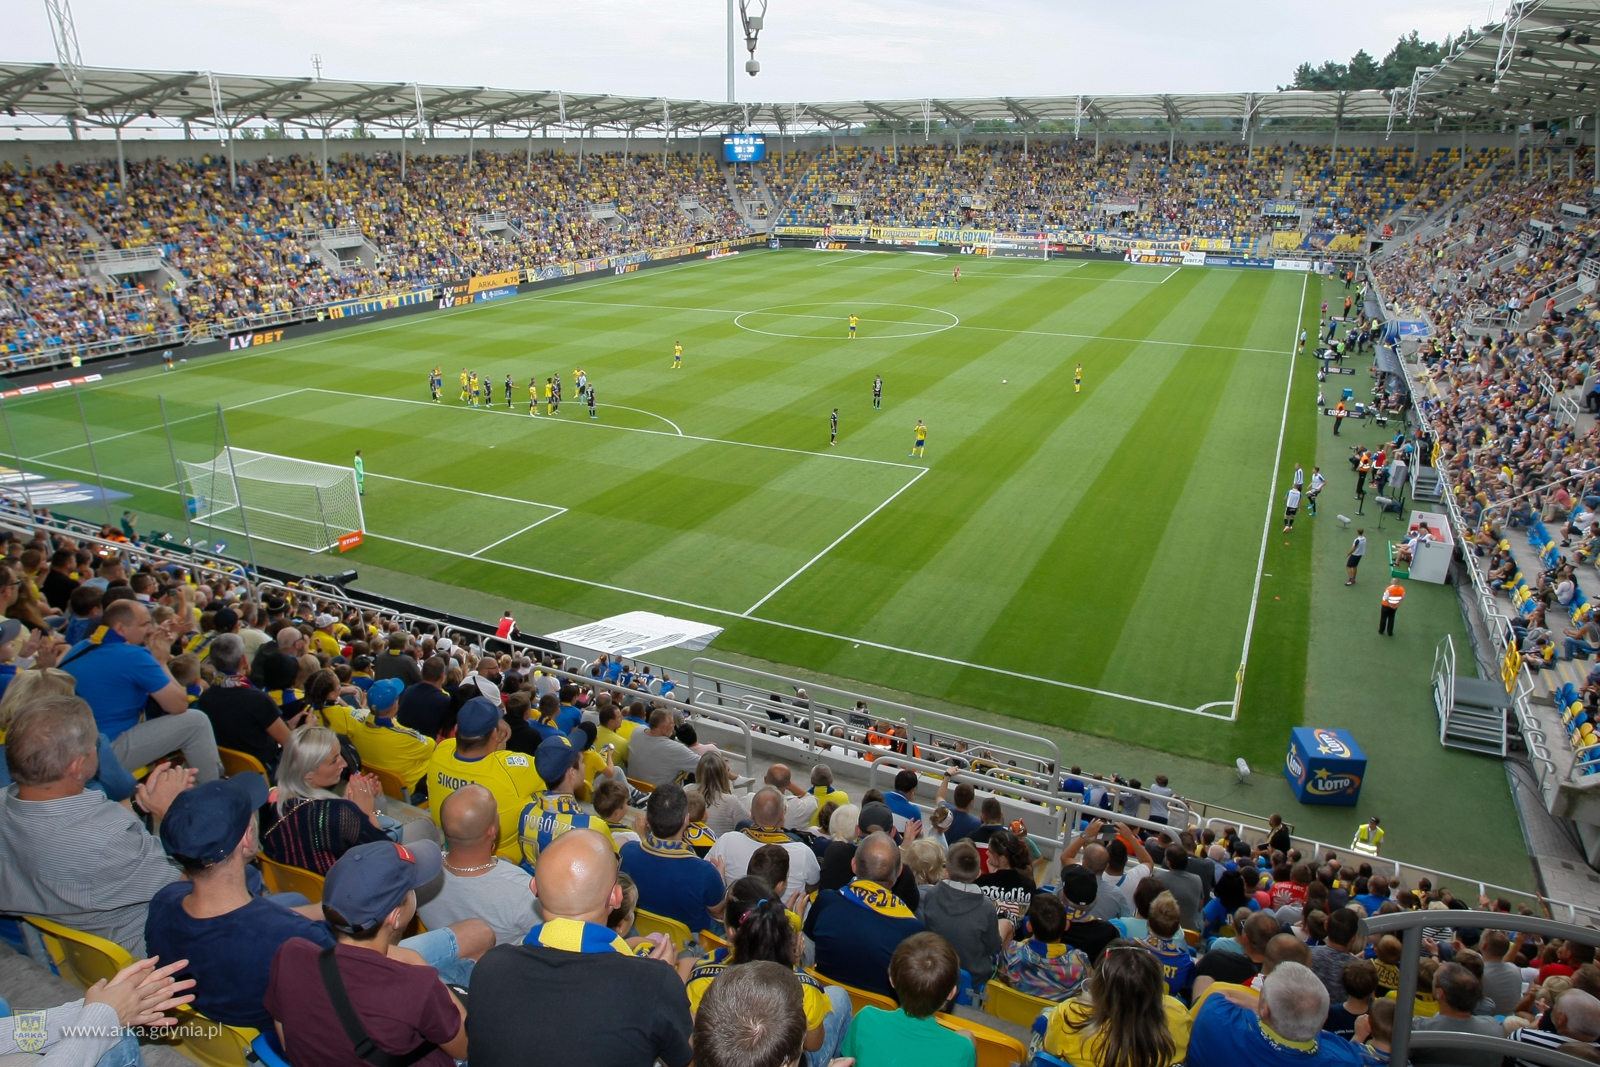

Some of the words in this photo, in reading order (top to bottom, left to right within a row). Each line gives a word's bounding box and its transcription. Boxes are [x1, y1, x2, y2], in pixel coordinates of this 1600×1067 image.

[1275, 205, 1296, 213] PDW
[938, 230, 960, 241] ARKA
[962, 231, 992, 243] GDYNIA
[1108, 240, 1137, 248] MZKS
[478, 280, 498, 289] ARKA:
[1318, 778, 1350, 791] LOTTO
